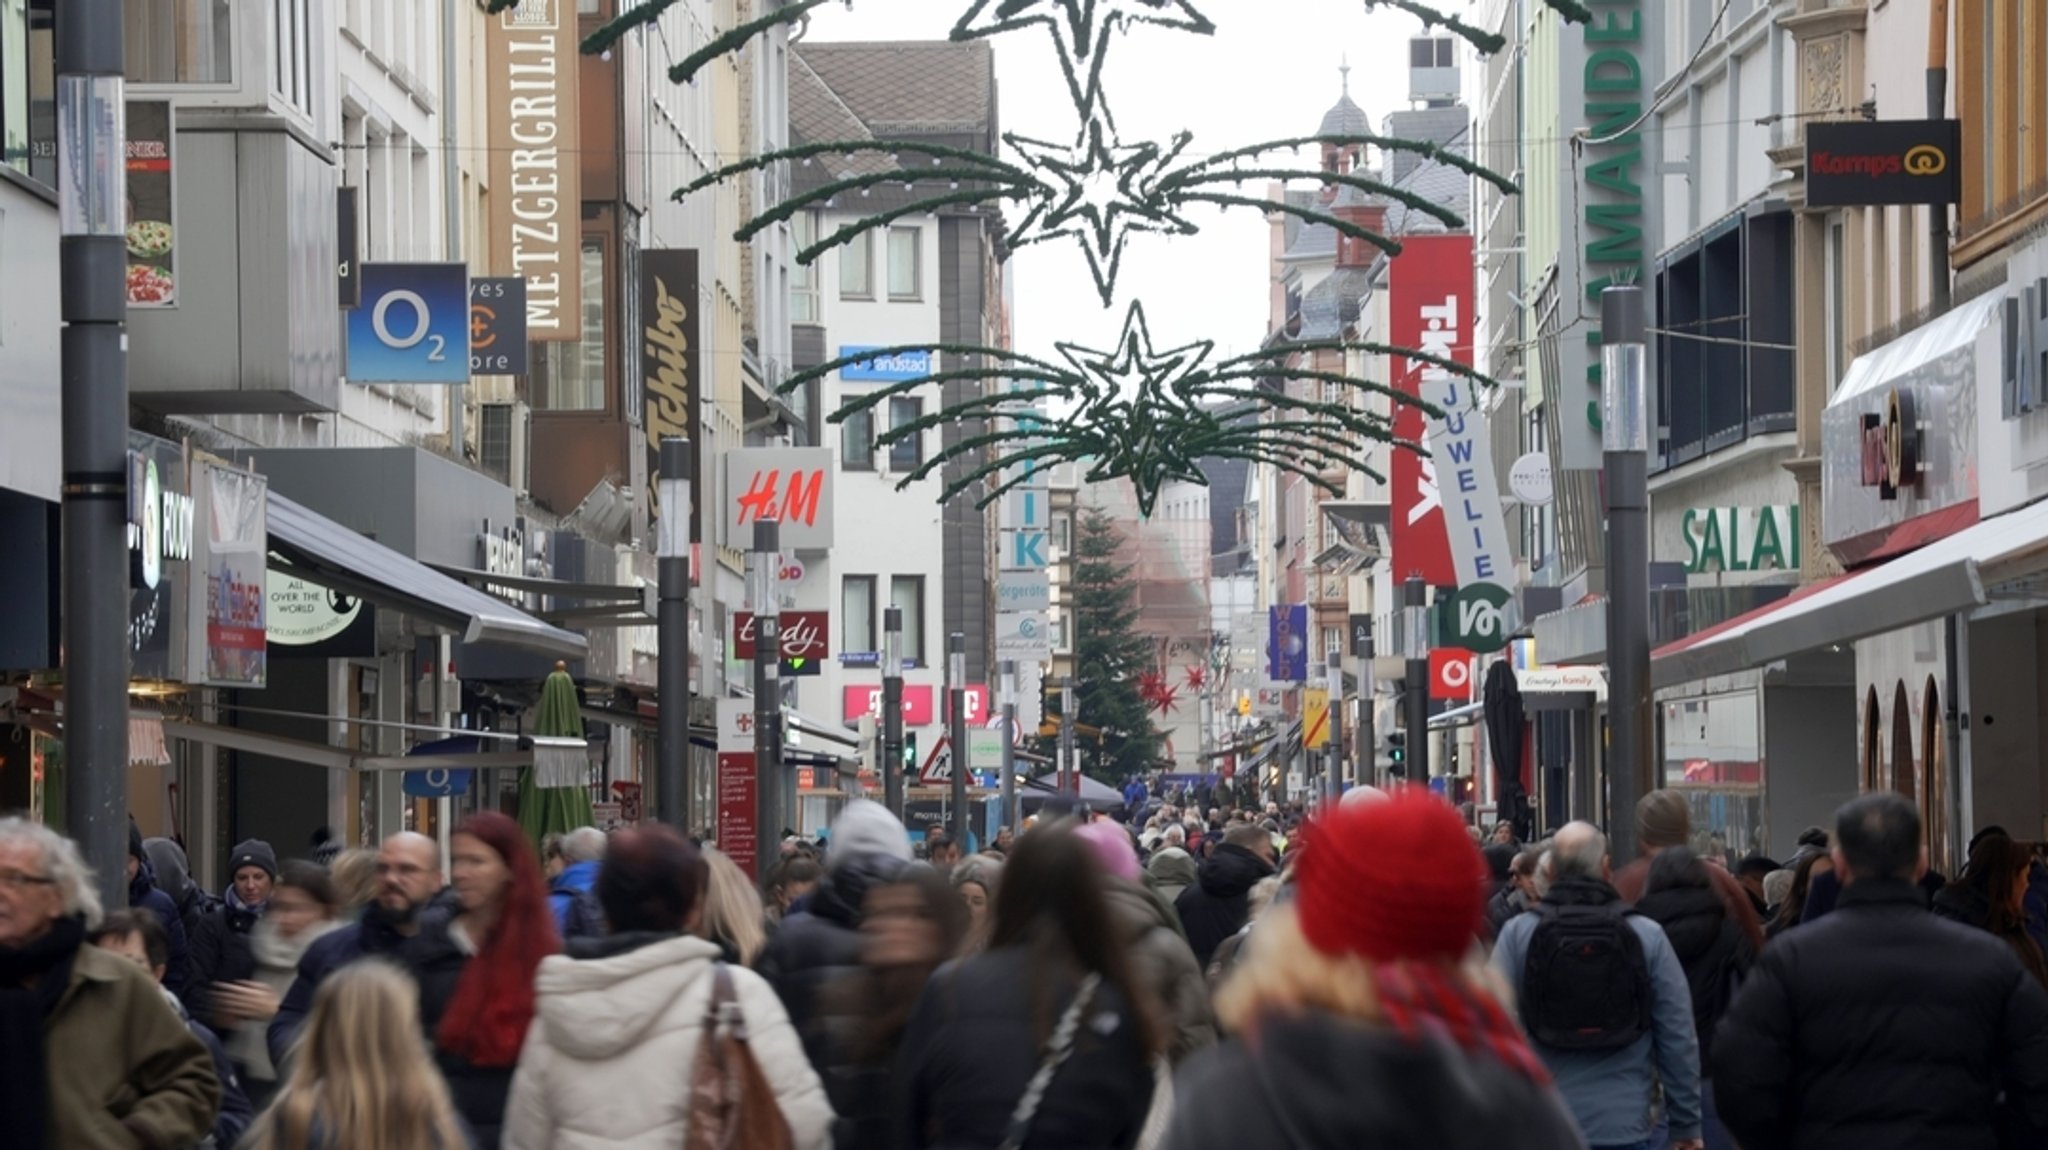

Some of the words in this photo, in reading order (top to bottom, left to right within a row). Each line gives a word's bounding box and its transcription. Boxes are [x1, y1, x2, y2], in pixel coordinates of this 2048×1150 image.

[1813, 152, 1901, 178] Kamps
[509, 35, 560, 329] METZGERGRILL
[647, 275, 688, 453] Tchibo
[873, 356, 927, 372] andstad
[737, 469, 825, 528] H&M
[288, 581, 304, 590] ALL
[271, 592, 298, 602] OVER
[303, 592, 320, 601] THE
[278, 604, 315, 613] WORLD
